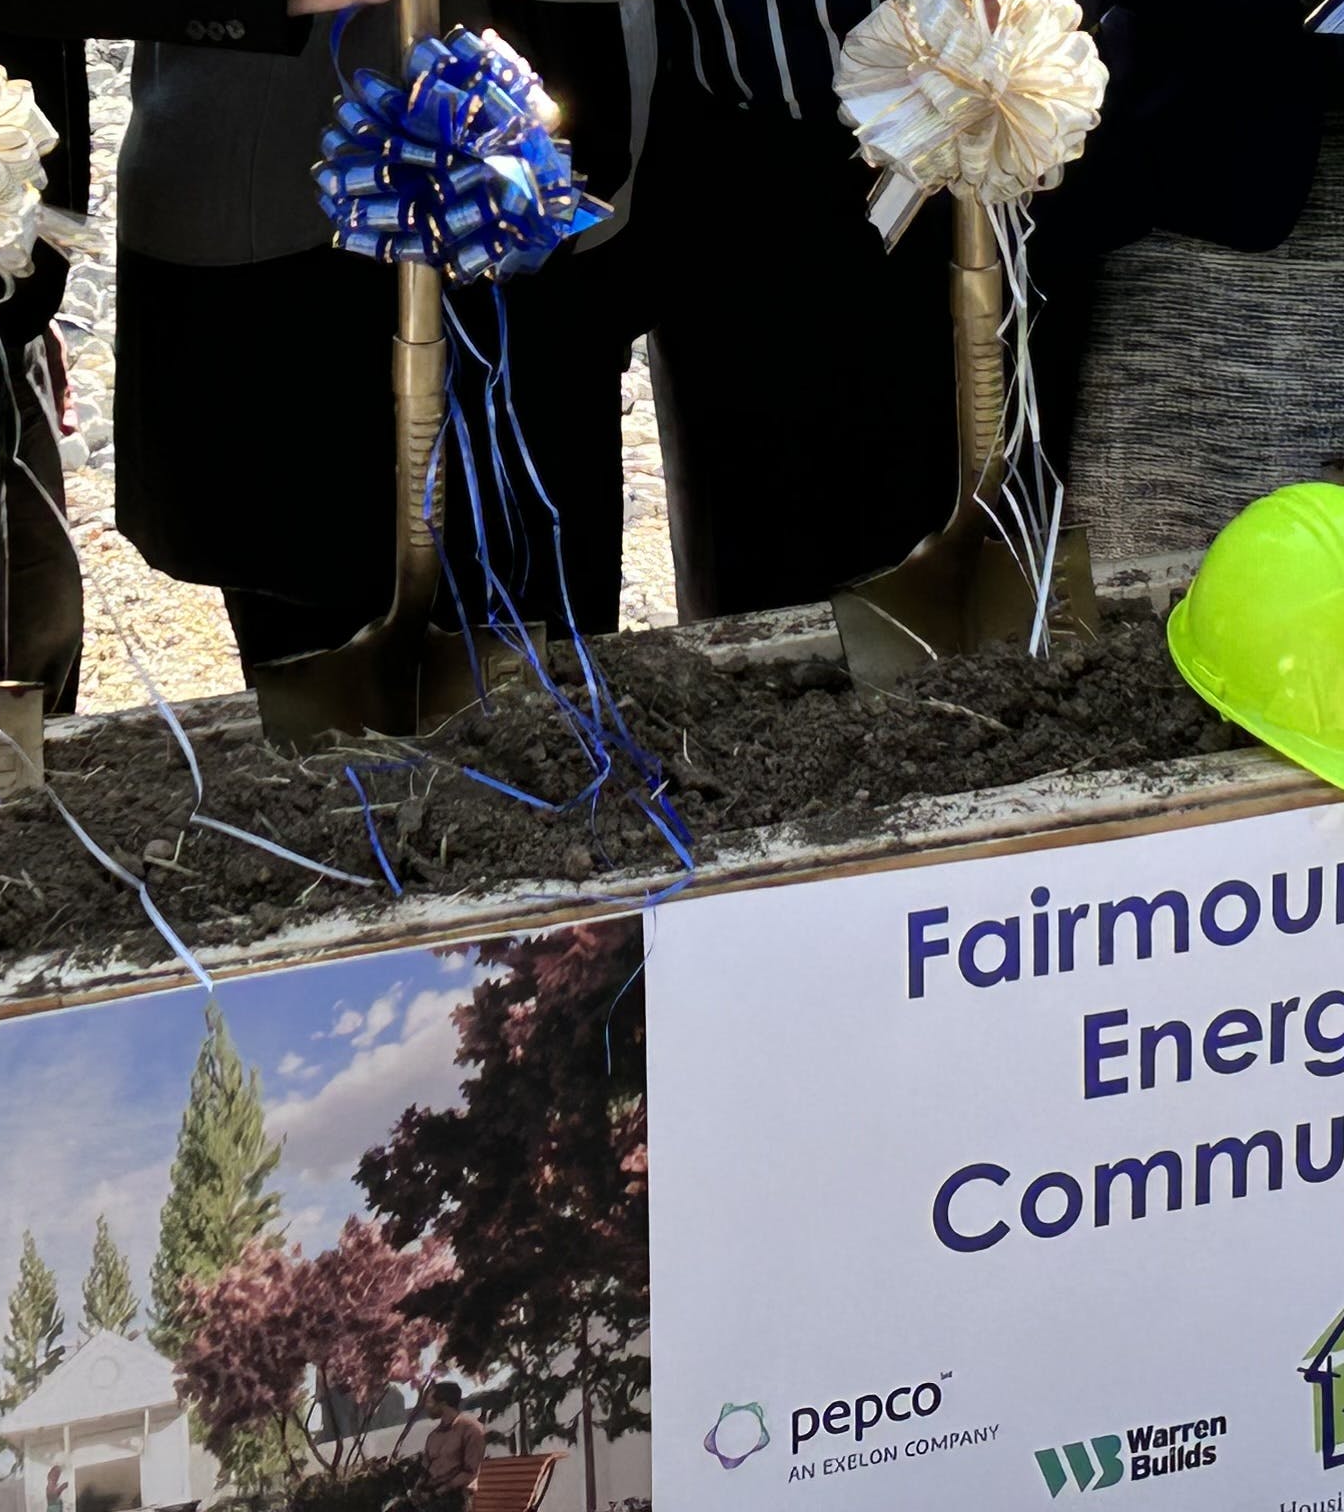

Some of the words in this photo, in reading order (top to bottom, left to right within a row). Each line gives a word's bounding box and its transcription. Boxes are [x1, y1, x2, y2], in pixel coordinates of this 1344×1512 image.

[792, 1383, 941, 1455] pepco
[1127, 1416, 1227, 1453] Warren
[789, 1463, 815, 1483] AN
[823, 1446, 897, 1475] EXELON
[905, 1424, 999, 1457] COMPANY
[1131, 1441, 1216, 1481] Builds
